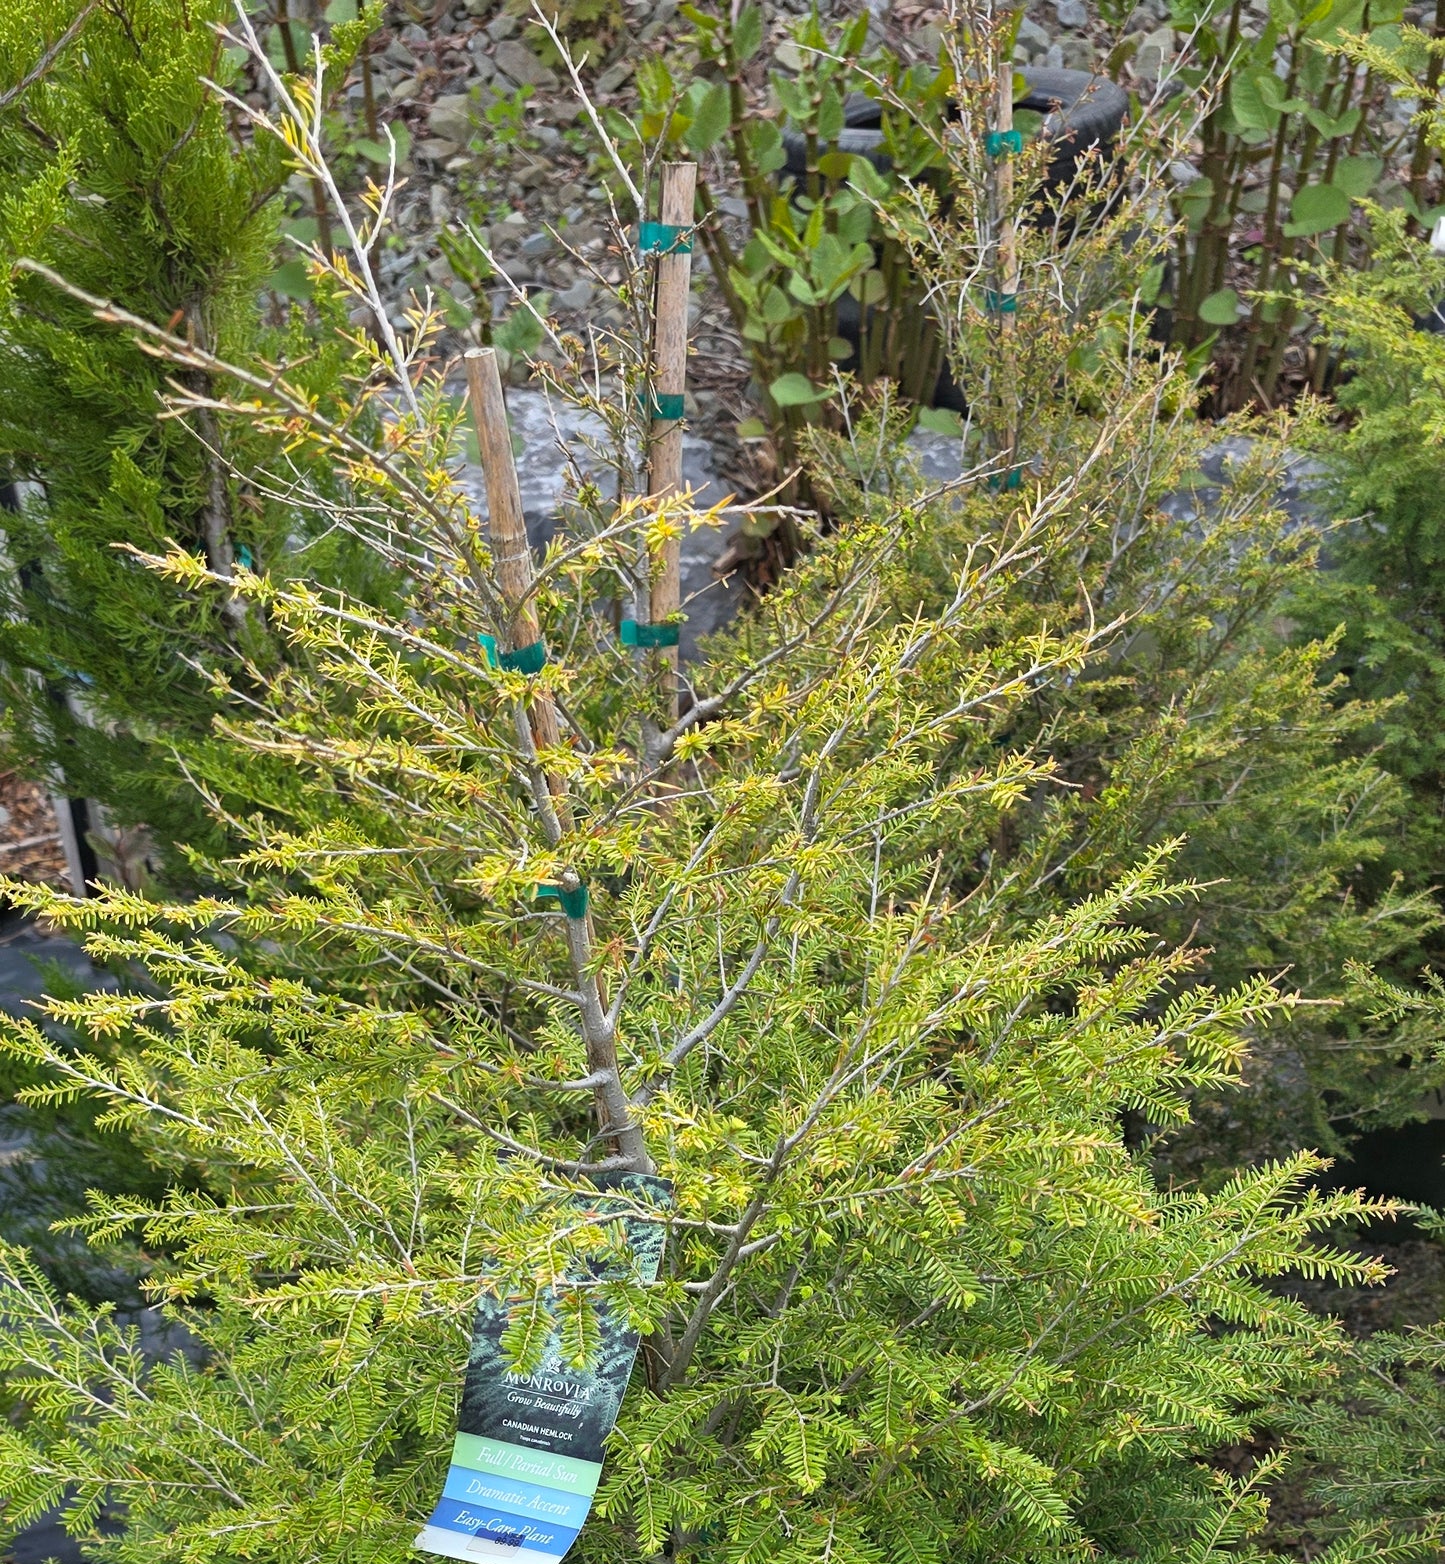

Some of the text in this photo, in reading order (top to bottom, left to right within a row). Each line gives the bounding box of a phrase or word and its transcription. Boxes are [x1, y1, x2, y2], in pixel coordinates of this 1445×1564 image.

[505, 1371, 590, 1400] MONROVIA
[507, 1391, 581, 1419] Grow Beautifully
[502, 1418, 573, 1441] CANADIAN HEMLOCK
[477, 1446, 578, 1483] Full / Partial Sun
[466, 1479, 571, 1516] Dramatic Accent
[453, 1509, 554, 1545] Easy-Care Plant
